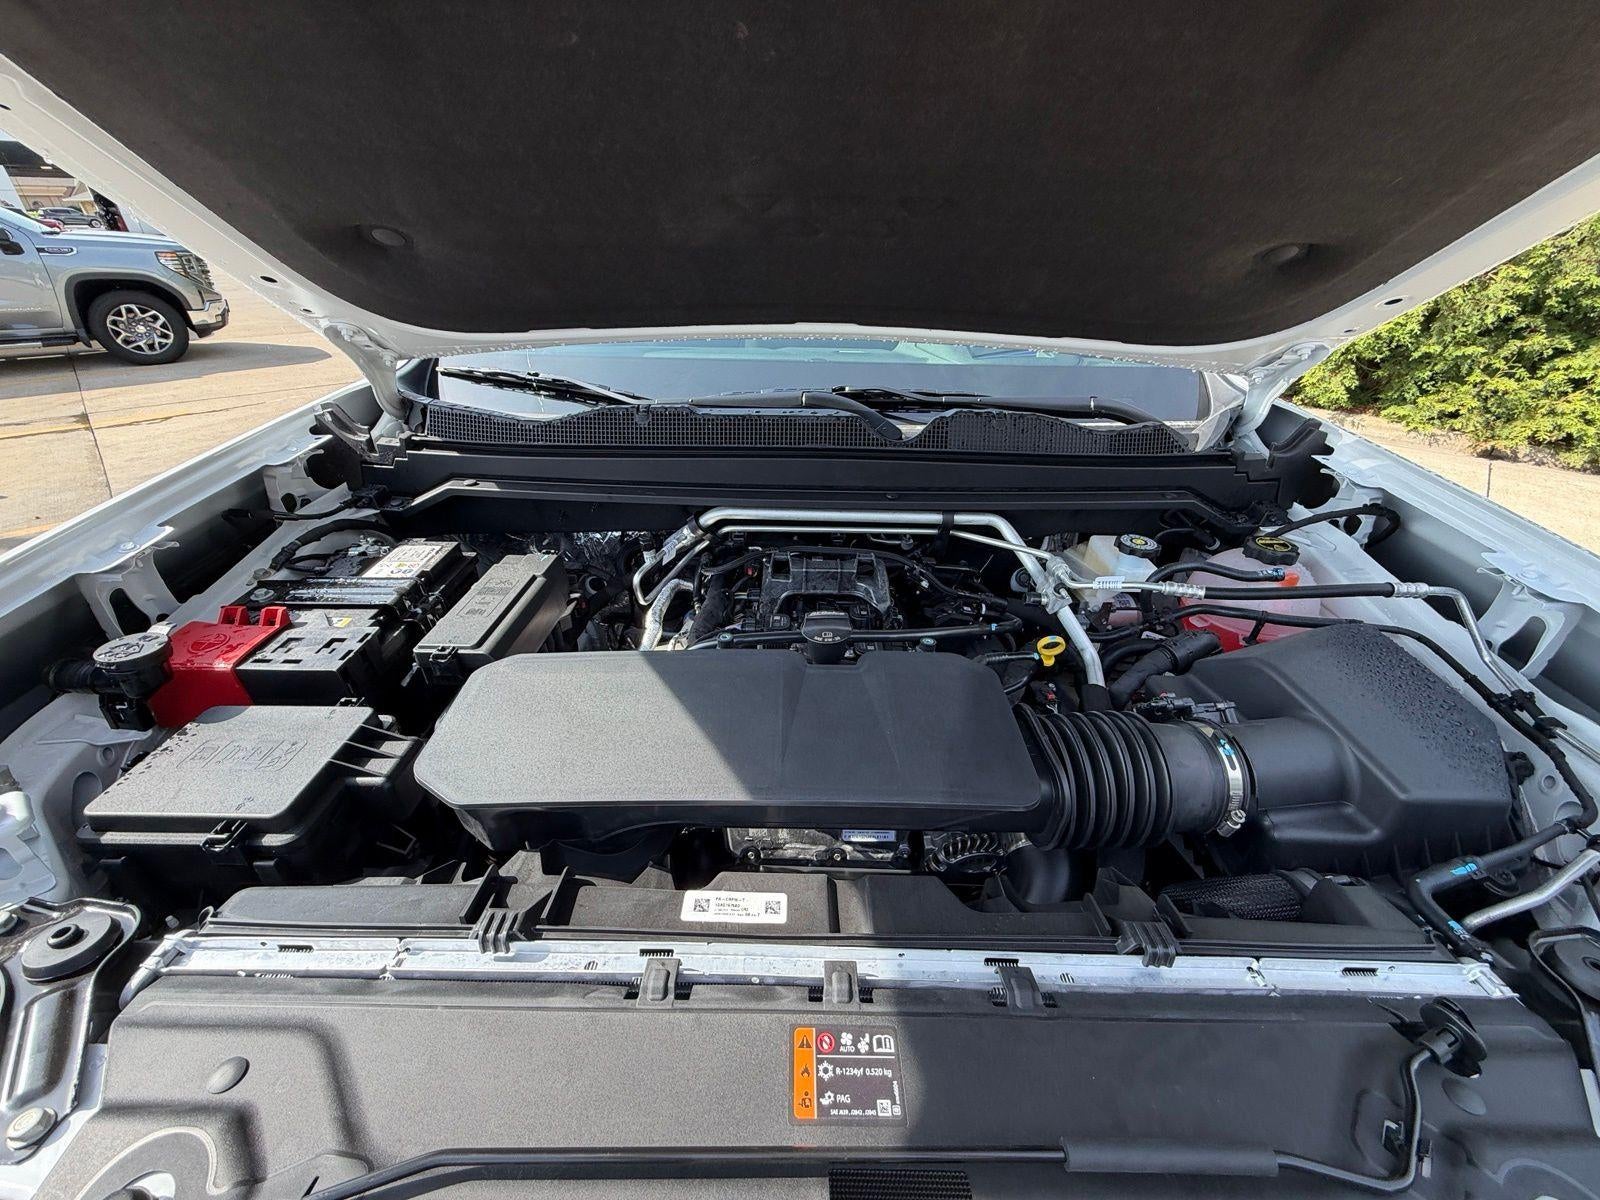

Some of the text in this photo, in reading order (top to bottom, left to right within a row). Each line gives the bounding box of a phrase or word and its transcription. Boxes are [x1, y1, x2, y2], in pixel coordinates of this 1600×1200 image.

[835, 1067, 892, 1078] R-1234yf 0.520 kg
[836, 1095, 851, 1103] PAG
